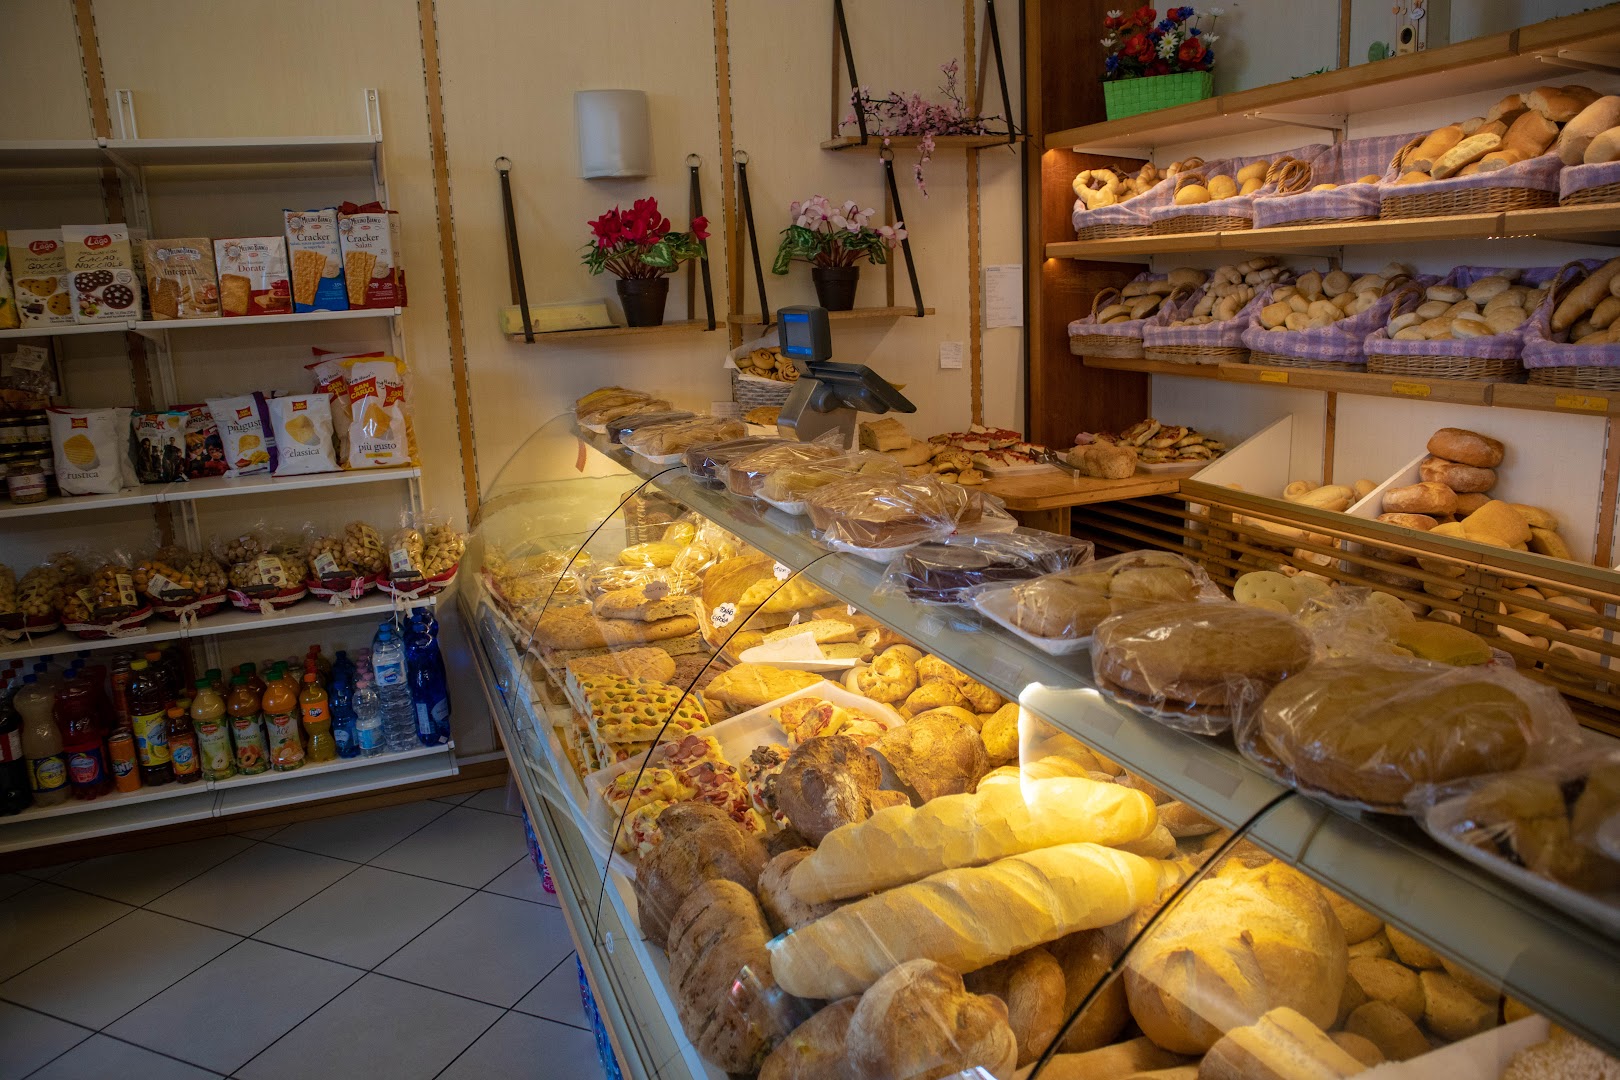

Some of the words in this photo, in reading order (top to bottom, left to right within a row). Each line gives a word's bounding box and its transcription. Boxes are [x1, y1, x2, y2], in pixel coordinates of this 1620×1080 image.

[87, 235, 109, 247] Lago
[297, 233, 330, 243] Cracker
[346, 233, 379, 243] Cracker
[33, 241, 54, 252] Lago
[78, 255, 115, 263] CACAO
[28, 262, 63, 270] GOCCE
[75, 261, 124, 269] NOCCIOLE
[238, 264, 266, 273] Dorate
[350, 386, 375, 399] CARLO
[354, 382, 369, 393] SAN
[136, 417, 165, 431] JUNIOR
[186, 412, 214, 429] JUNIOR
[290, 447, 320, 458] classica
[358, 442, 373, 454] più
[374, 442, 397, 453] gusto
[68, 472, 99, 480] rustica
